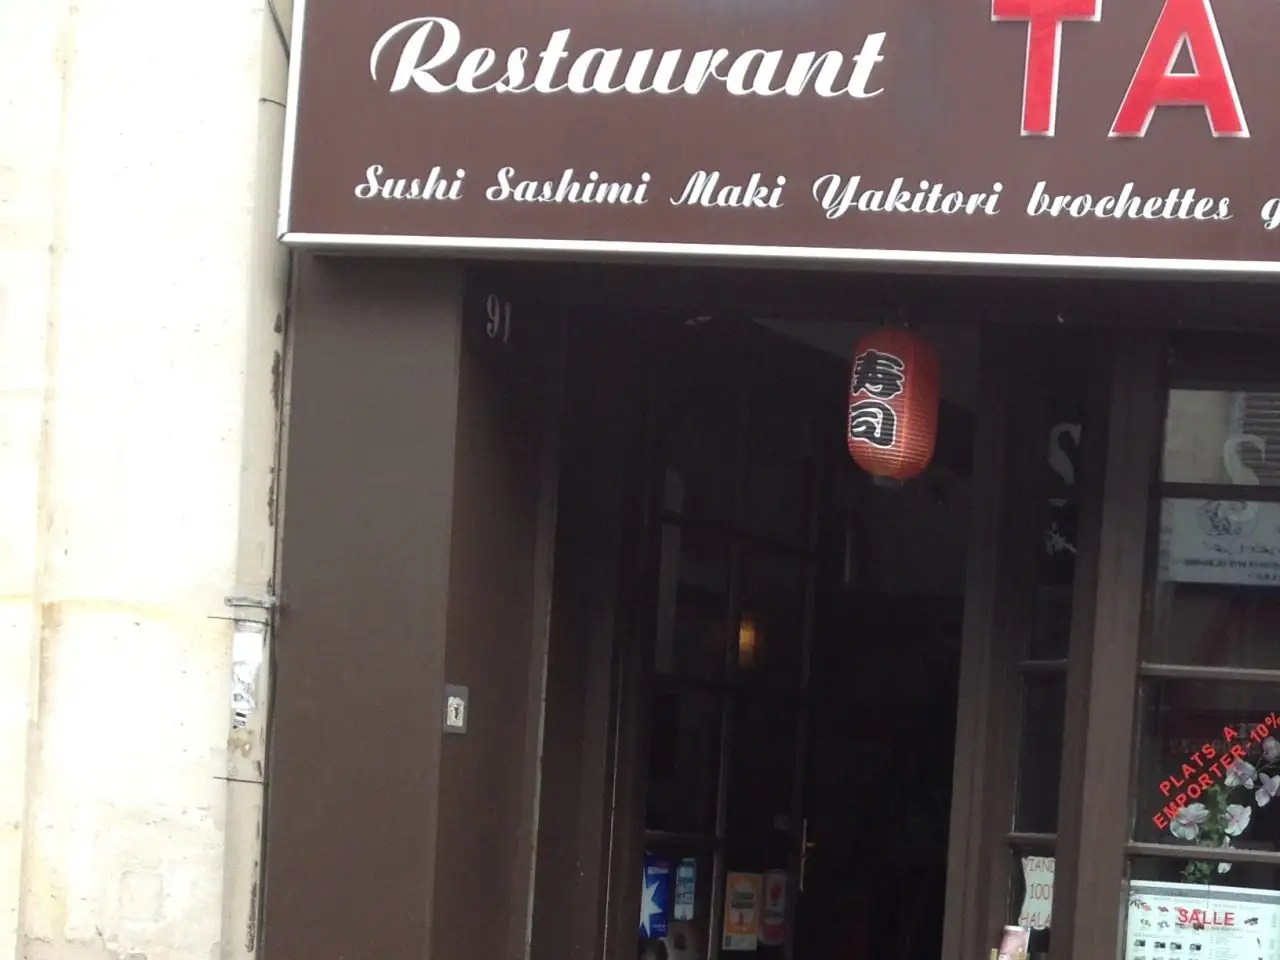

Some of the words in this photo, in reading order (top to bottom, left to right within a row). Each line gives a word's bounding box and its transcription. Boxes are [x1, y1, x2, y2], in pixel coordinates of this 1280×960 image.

[370, 17, 886, 98] Restaurant
[355, 165, 465, 201] Sushi
[486, 167, 650, 205] Sashimi
[670, 171, 786, 209] Maki
[813, 174, 1003, 220] Yakitori
[1027, 181, 1232, 221] brochettes
[1159, 743, 1216, 796] PLATS
[1223, 726, 1238, 742] A
[1178, 908, 1235, 927] SALLE
